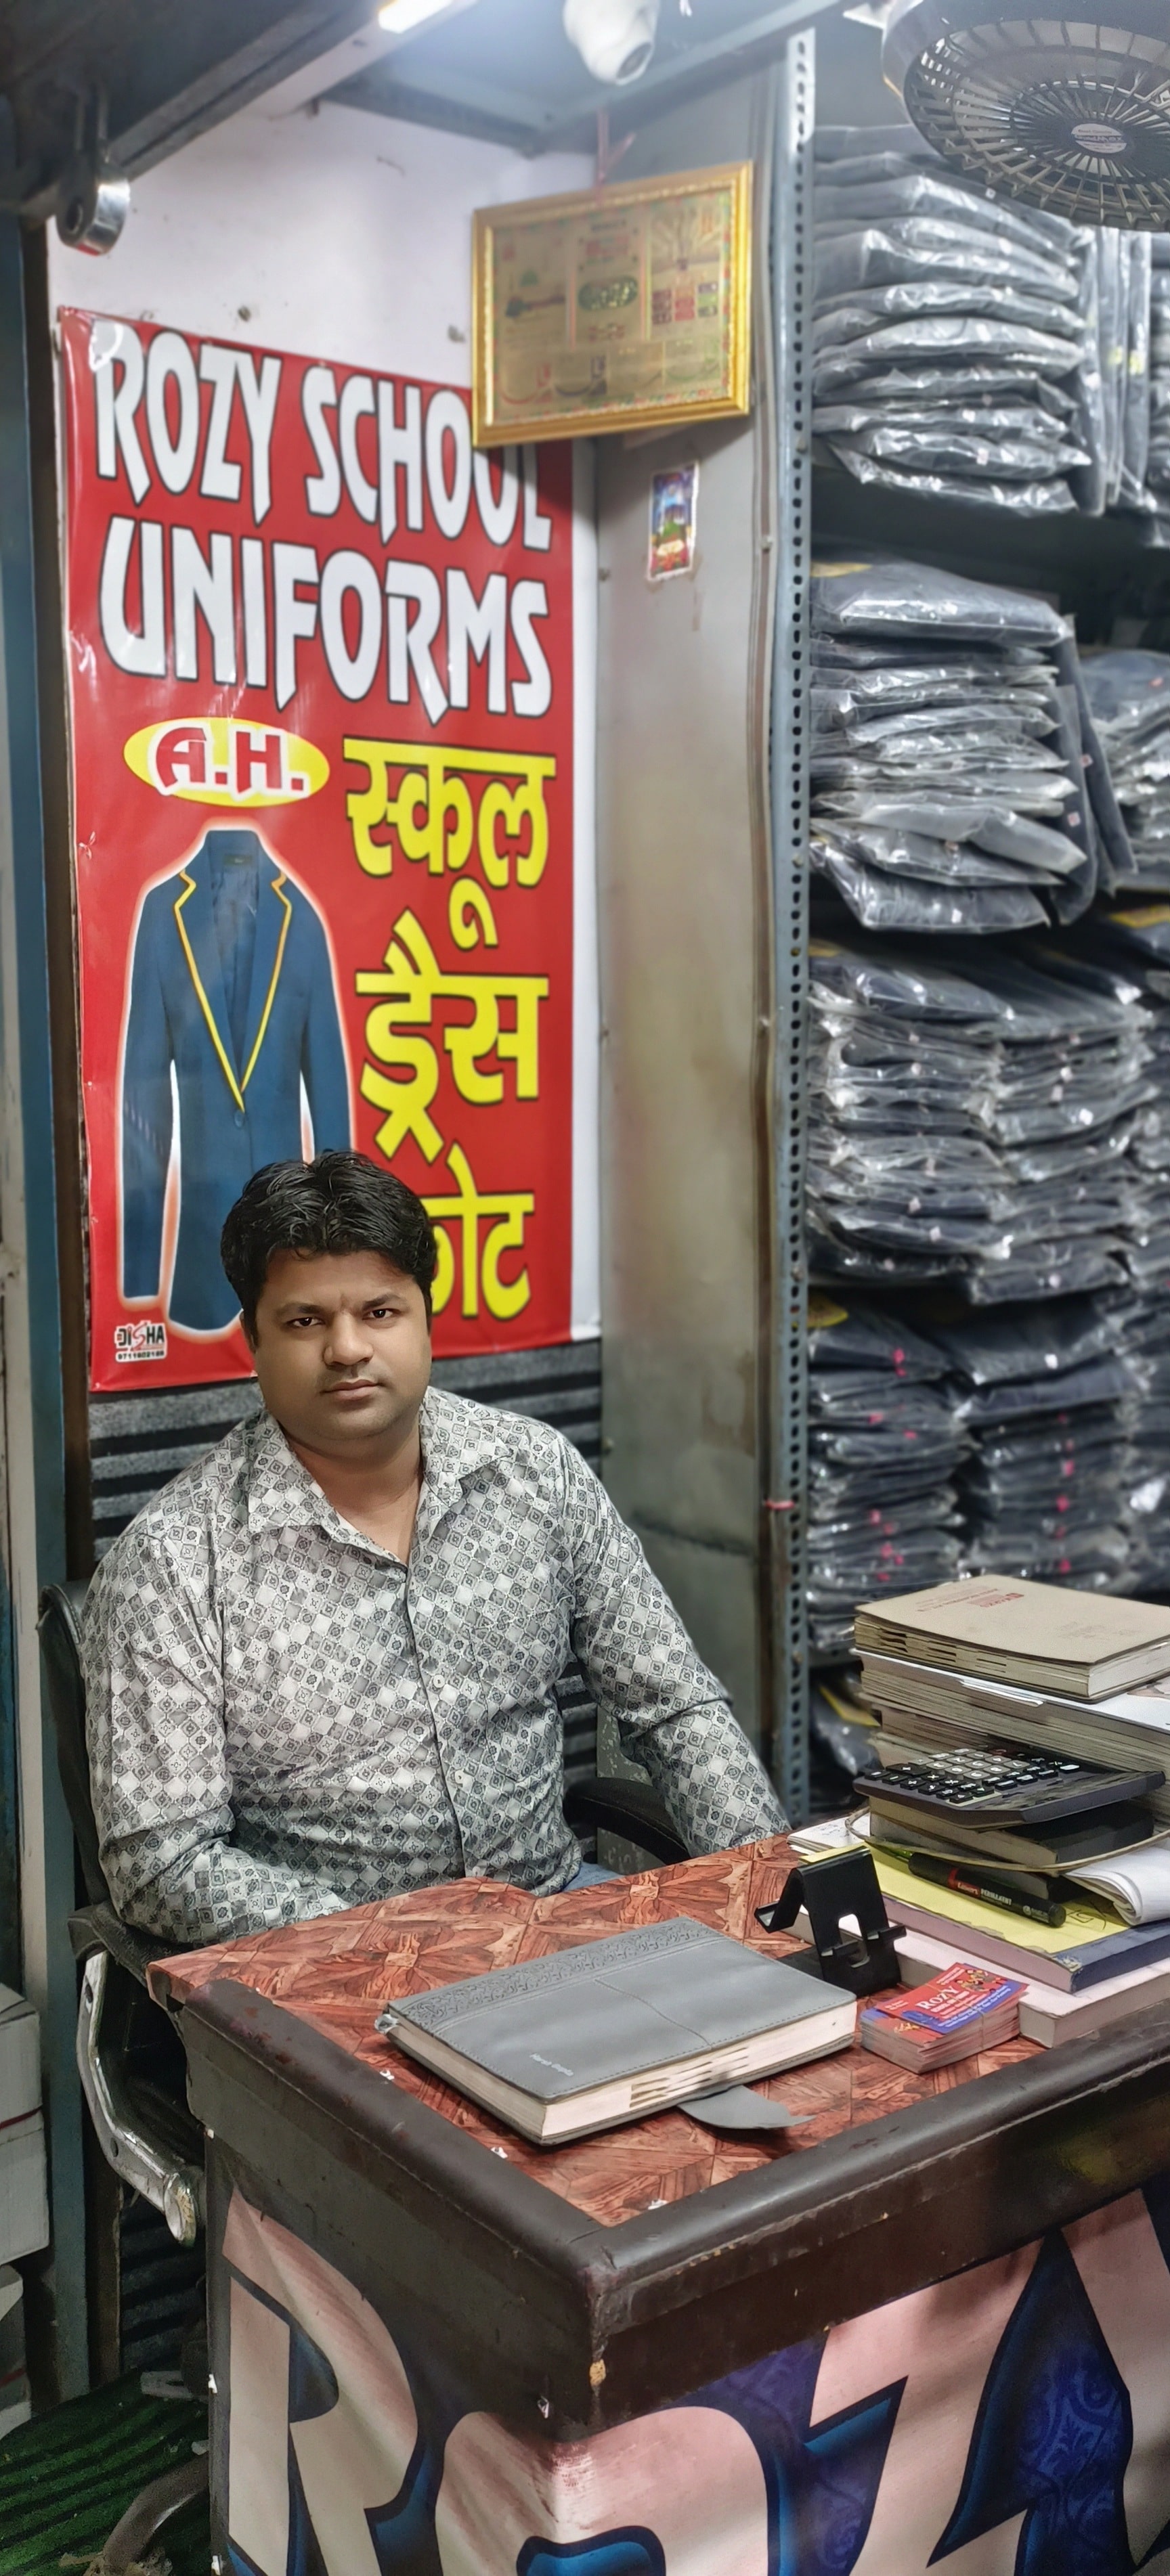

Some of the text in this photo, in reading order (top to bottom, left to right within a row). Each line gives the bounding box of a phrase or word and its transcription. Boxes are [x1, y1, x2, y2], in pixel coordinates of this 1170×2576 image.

[89, 318, 552, 553] ROZY SCHOOL
[99, 515, 552, 726] UNIFORMS
[153, 726, 309, 795] A.H.
[343, 736, 556, 950] स्कूल
[915, 1985, 959, 2009] ROZY
